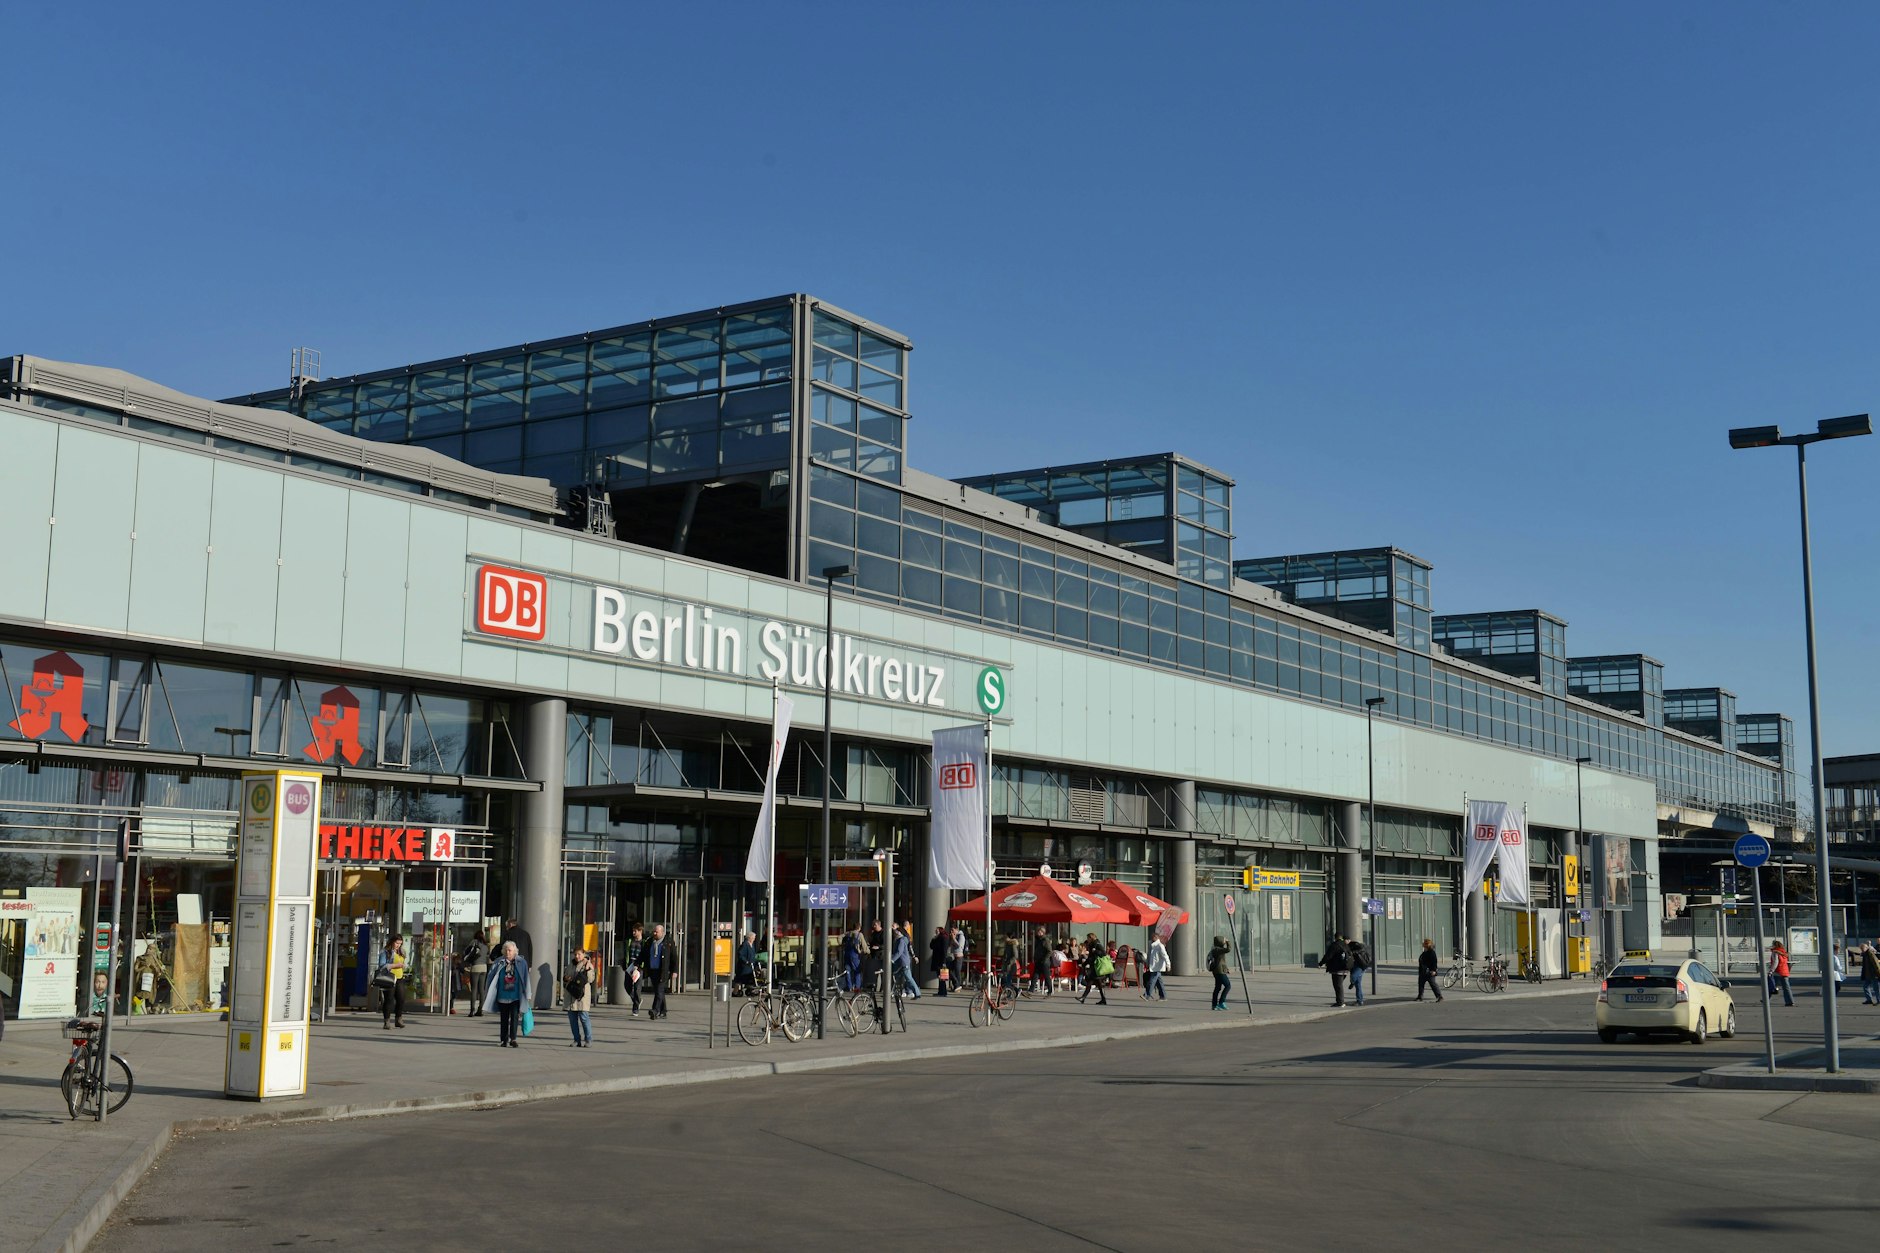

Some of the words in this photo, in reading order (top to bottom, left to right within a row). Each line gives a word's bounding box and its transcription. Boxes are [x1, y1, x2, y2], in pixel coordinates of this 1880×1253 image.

[487, 575, 539, 628] DB
[594, 585, 741, 675] Berlin
[760, 620, 945, 707] Südkreuz
[983, 671, 1001, 710] S
[255, 788, 266, 806] H
[287, 793, 309, 806] BUS
[1477, 826, 1495, 839] DB
[319, 825, 425, 861] THEKE
[1269, 874, 1297, 885] Bahnhof
[283, 991, 291, 1019] Einfach
[240, 1042, 251, 1050] BVG
[280, 1041, 292, 1050] BVG
